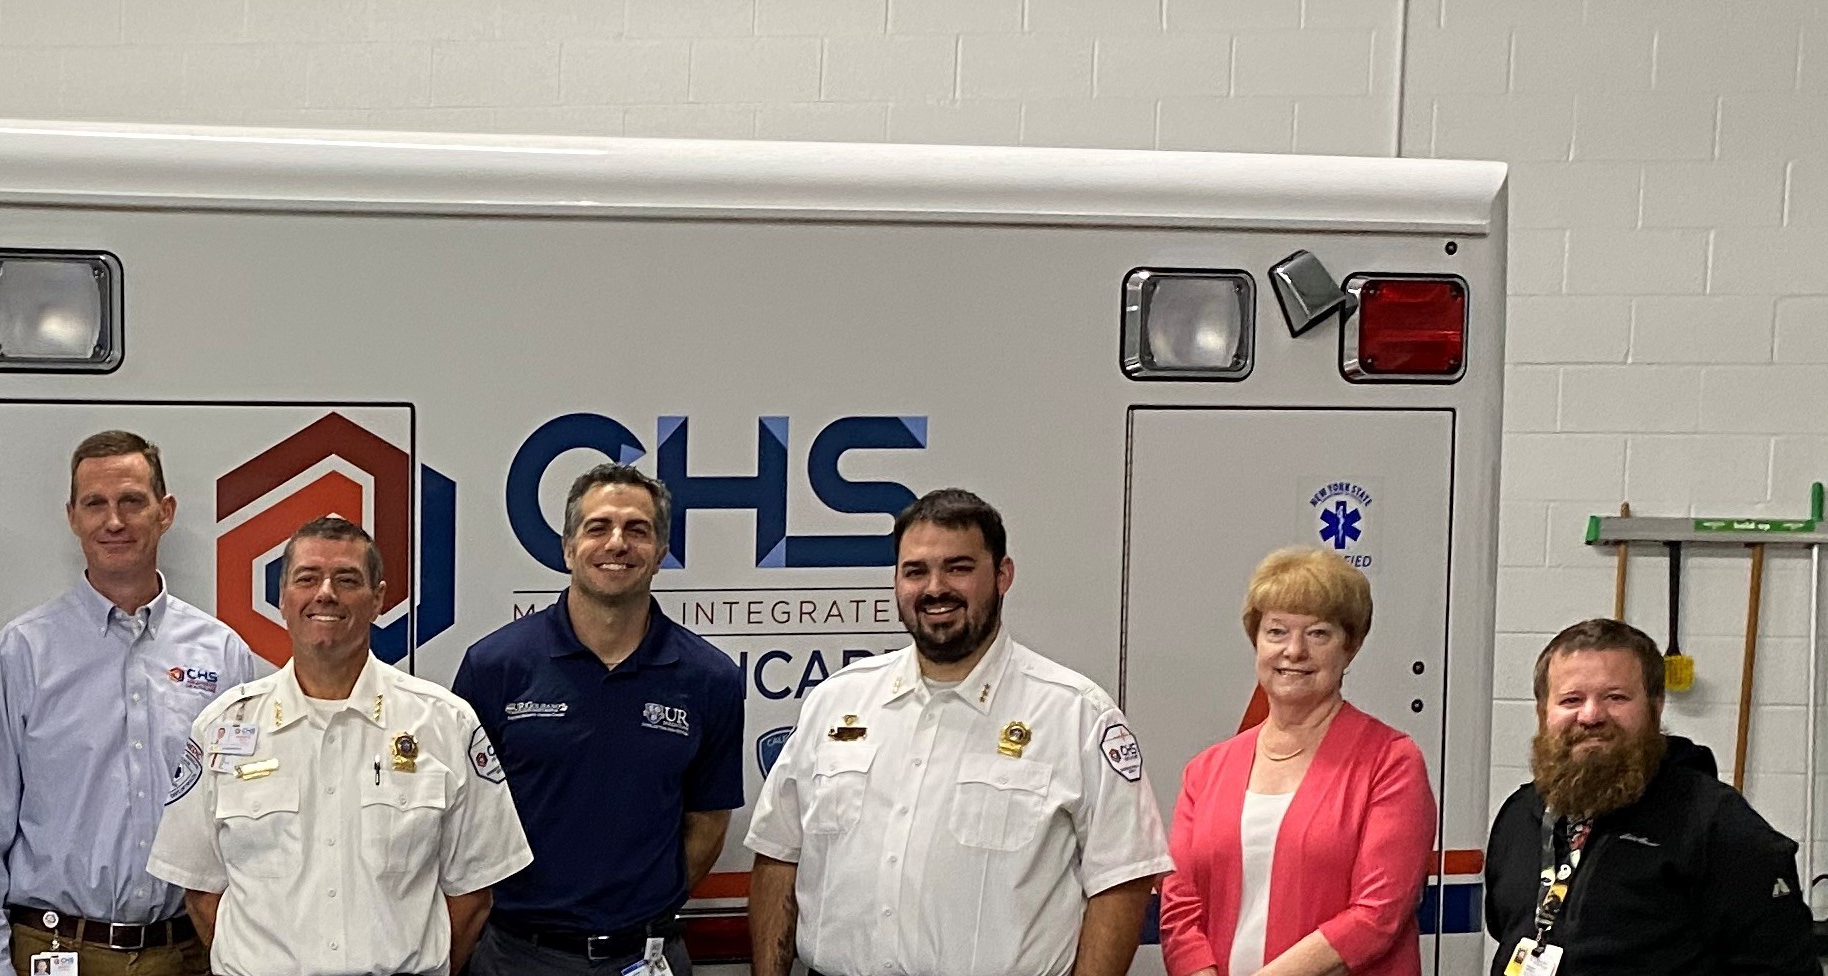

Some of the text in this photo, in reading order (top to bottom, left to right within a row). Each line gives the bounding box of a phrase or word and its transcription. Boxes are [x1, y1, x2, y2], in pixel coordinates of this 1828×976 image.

[506, 412, 928, 574] CHS
[682, 600, 904, 625] INTEGRATE
[187, 669, 218, 682] CHS
[665, 706, 689, 727] UR
